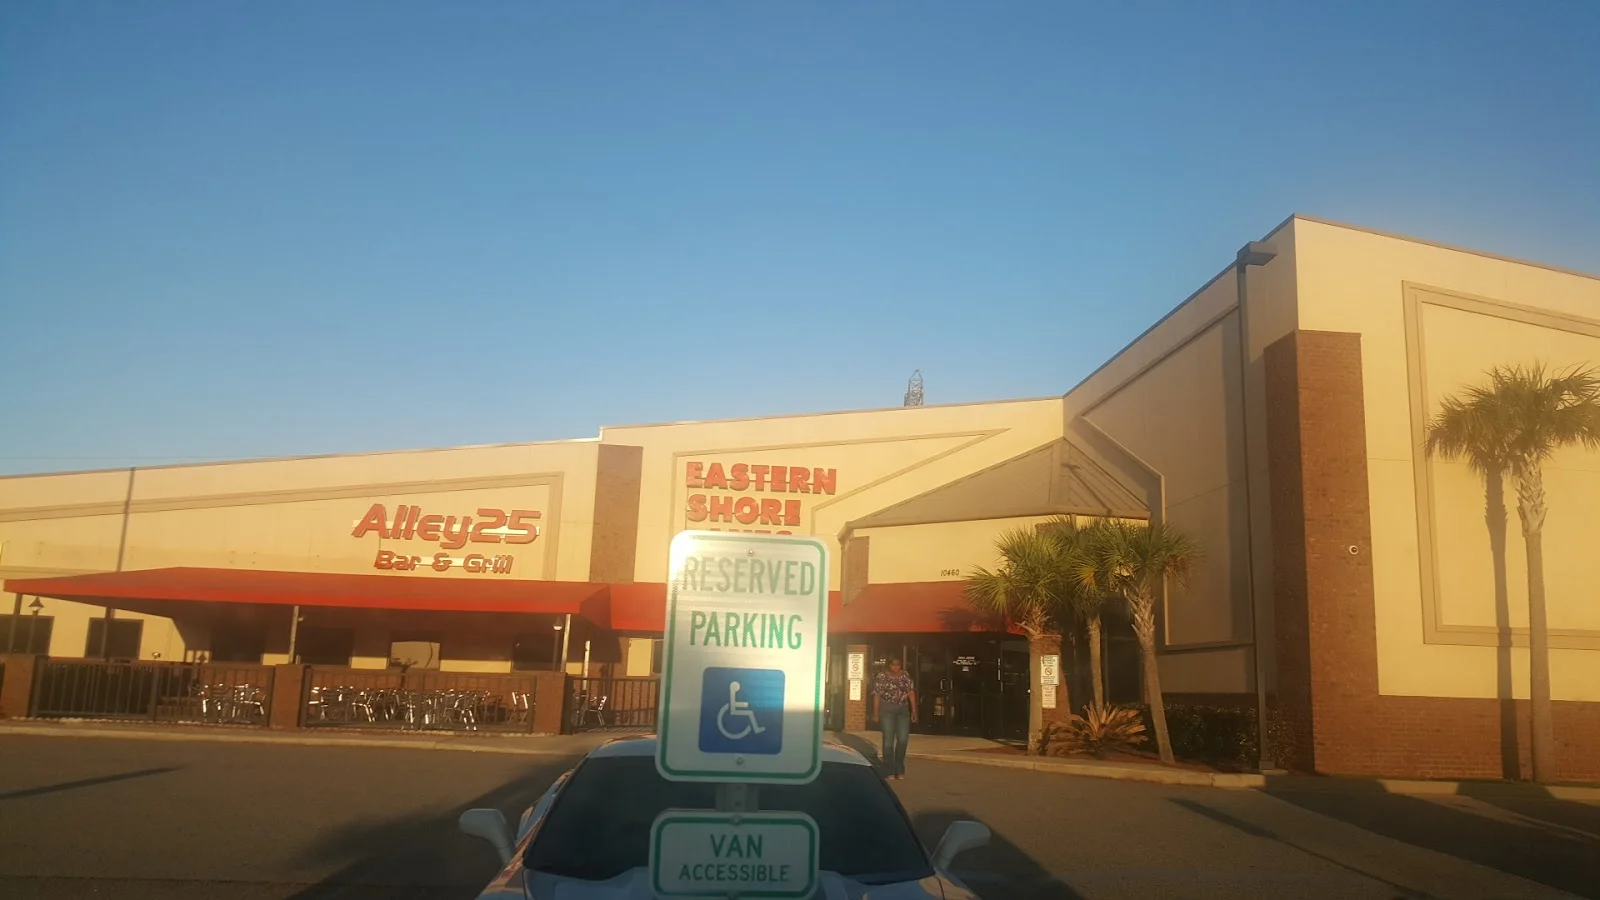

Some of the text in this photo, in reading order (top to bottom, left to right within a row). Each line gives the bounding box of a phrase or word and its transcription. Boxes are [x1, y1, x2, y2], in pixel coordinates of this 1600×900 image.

[686, 461, 837, 495] EASTERN
[687, 493, 802, 526] SHORE
[351, 503, 542, 550] Alley25
[374, 550, 514, 574] Bar & Grill
[682, 556, 816, 596] RESERVED
[940, 568, 960, 577] 10460
[690, 610, 802, 650] PARKING
[709, 833, 763, 859] VAN
[678, 863, 791, 882] ACCESSIBLE
